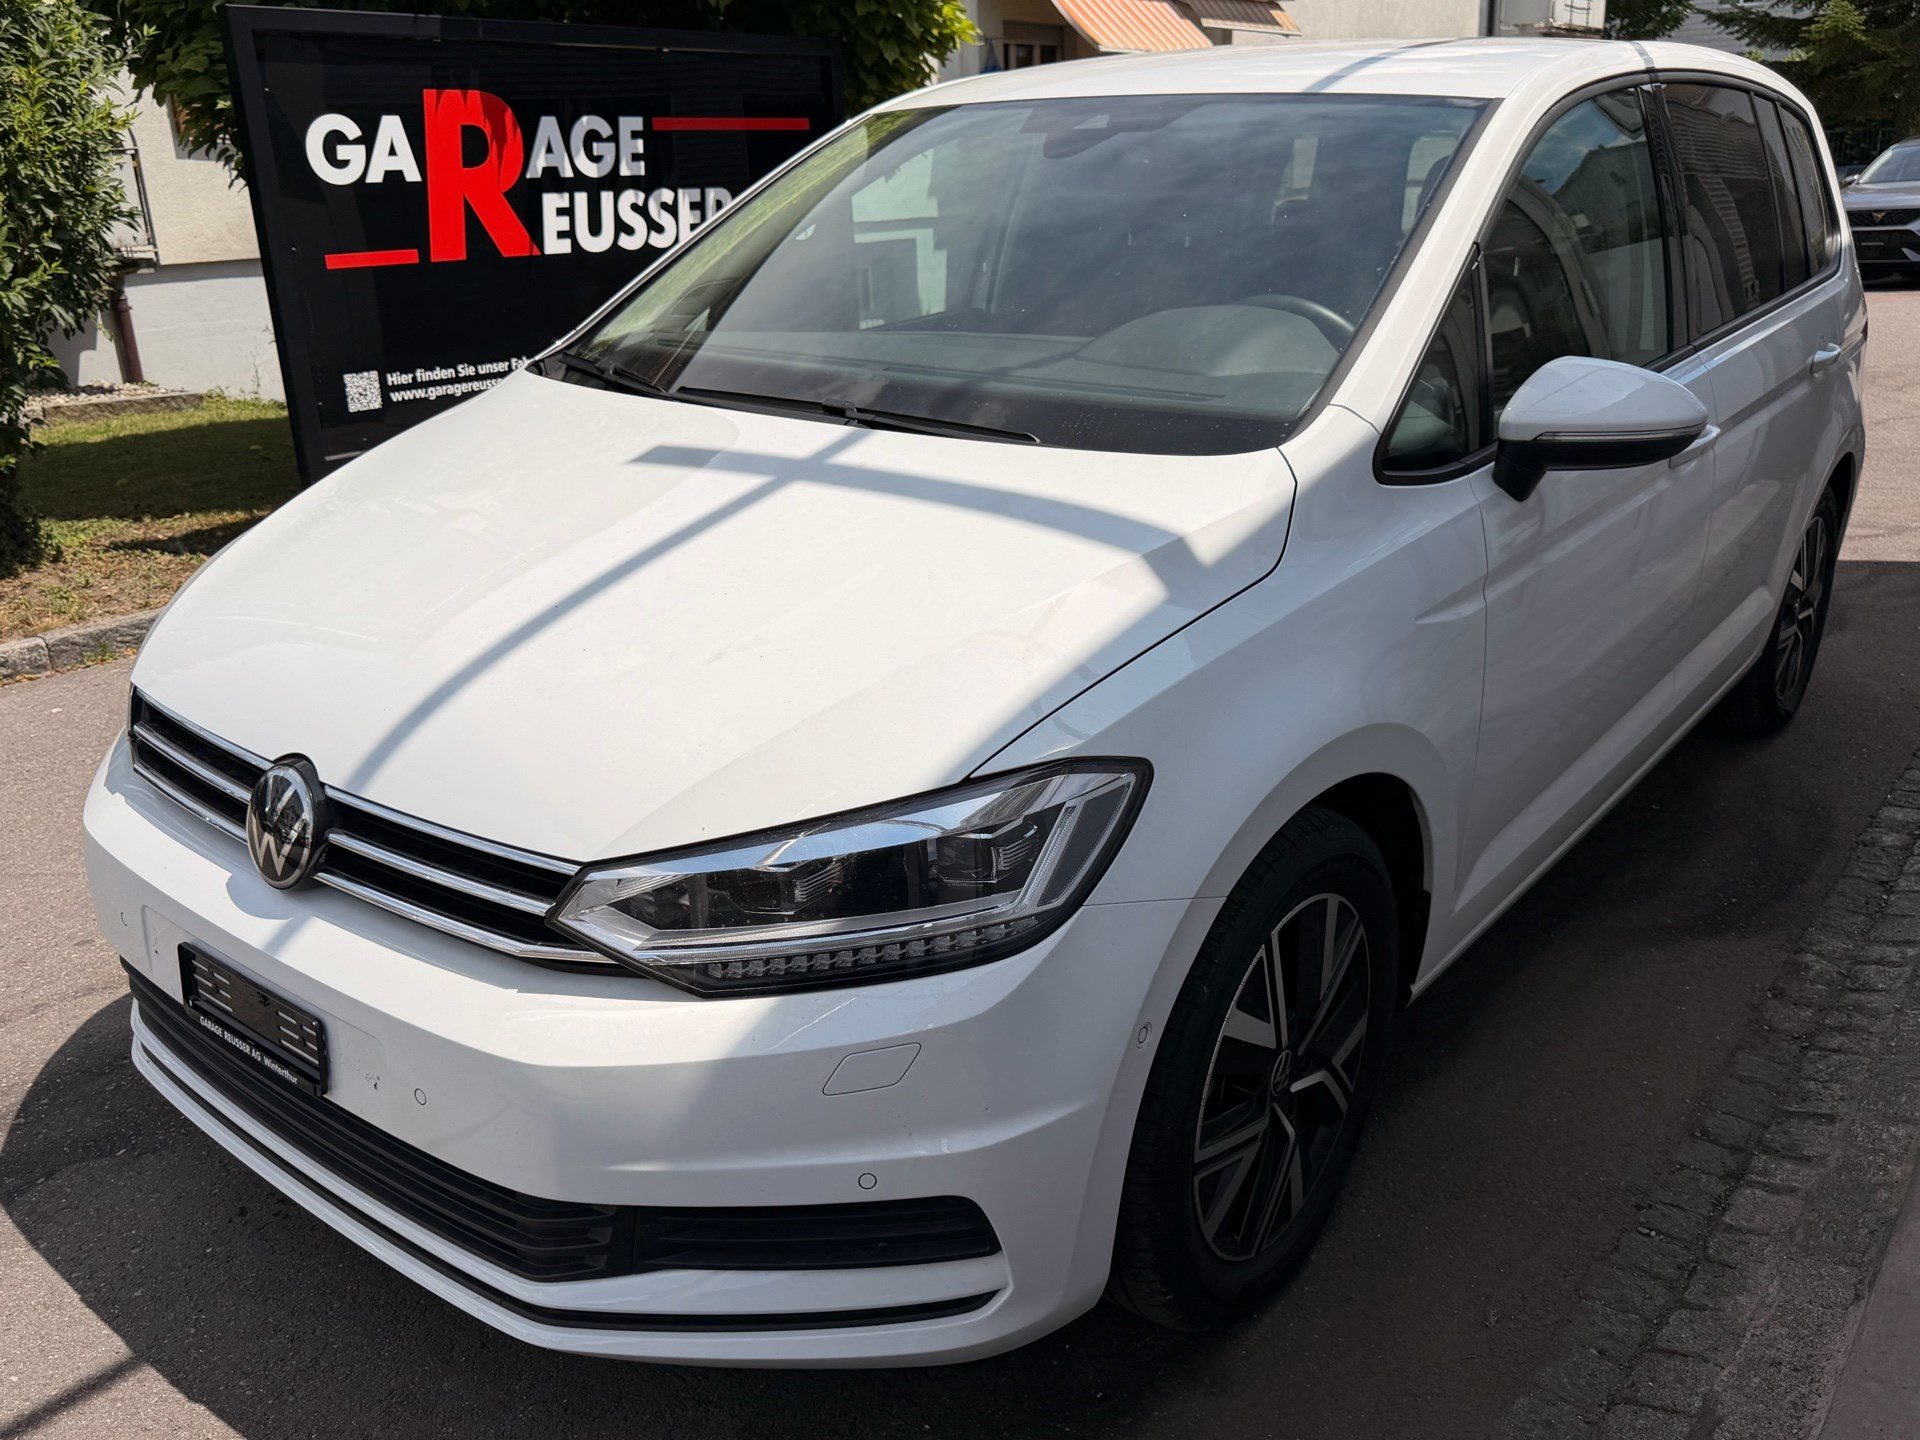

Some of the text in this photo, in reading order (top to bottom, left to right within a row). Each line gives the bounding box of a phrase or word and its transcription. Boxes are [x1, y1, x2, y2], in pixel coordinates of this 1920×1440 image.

[305, 88, 645, 262] GARAGE
[386, 373, 413, 386] Hier
[415, 366, 456, 383] finden
[457, 363, 476, 377] Sie
[478, 361, 510, 374] unser
[200, 1016, 298, 1085] GARAGE REUSSER AG Winterthur
